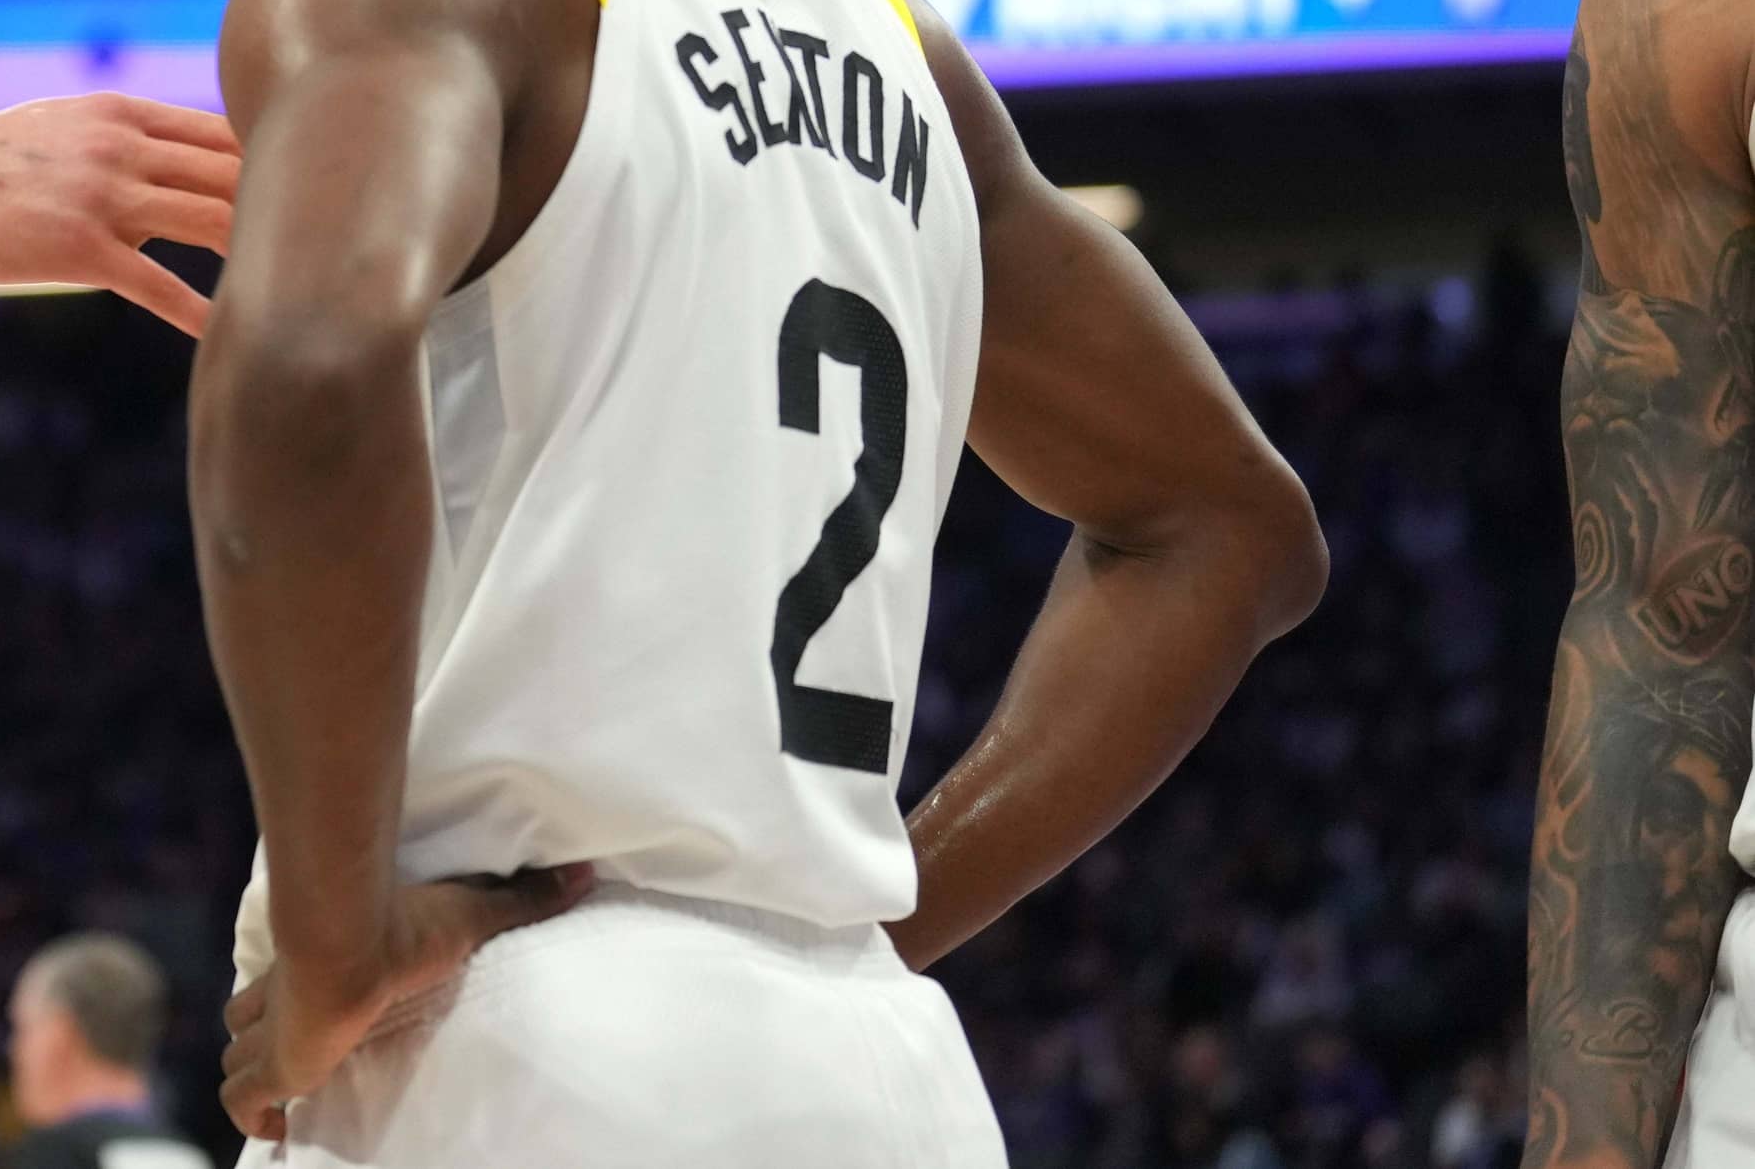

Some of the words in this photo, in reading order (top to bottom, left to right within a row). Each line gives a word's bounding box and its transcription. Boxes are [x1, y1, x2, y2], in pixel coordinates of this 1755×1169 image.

[674, 7, 929, 231] SEXTON
[770, 278, 907, 775] 2
[1640, 542, 1753, 646] UNO
